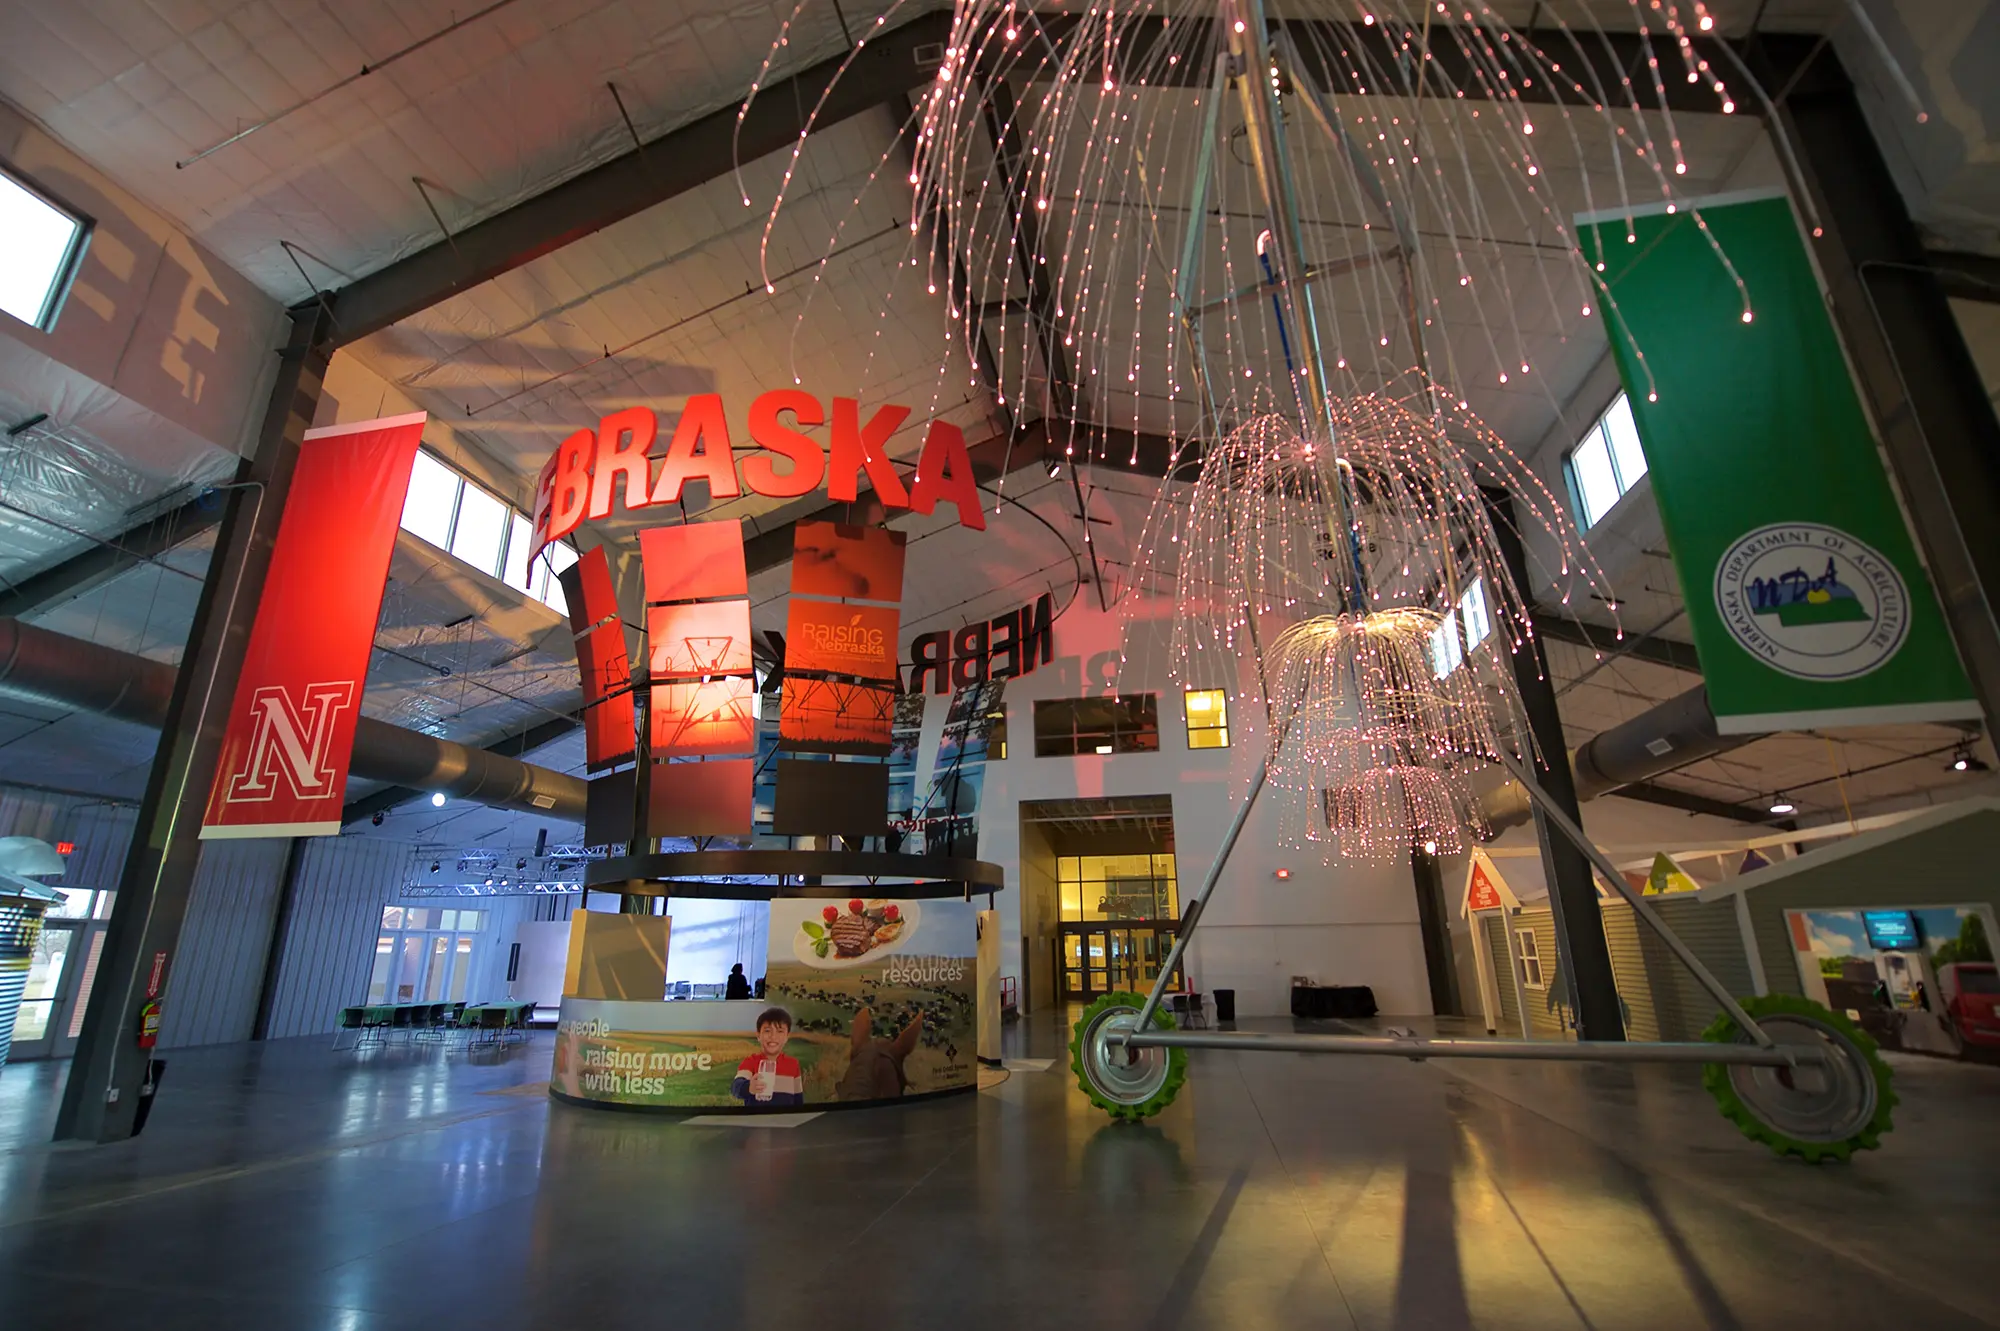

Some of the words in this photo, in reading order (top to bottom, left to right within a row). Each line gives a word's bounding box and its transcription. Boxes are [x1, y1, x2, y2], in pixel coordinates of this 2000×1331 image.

[525, 388, 986, 589] EBRASKA
[1726, 532, 1812, 582] DEPARTMENT
[1824, 535, 1847, 551] OF
[1852, 553, 1898, 649] AGRICULTURE
[1725, 590, 1779, 657] NEBRASKA
[814, 639, 885, 655] Nebraska
[226, 680, 355, 803] N
[882, 967, 963, 983] resources
[890, 953, 968, 972] NATURAL
[585, 1045, 646, 1075] raising
[649, 1051, 712, 1071] more
[585, 1068, 622, 1094] with
[625, 1071, 665, 1095] less
